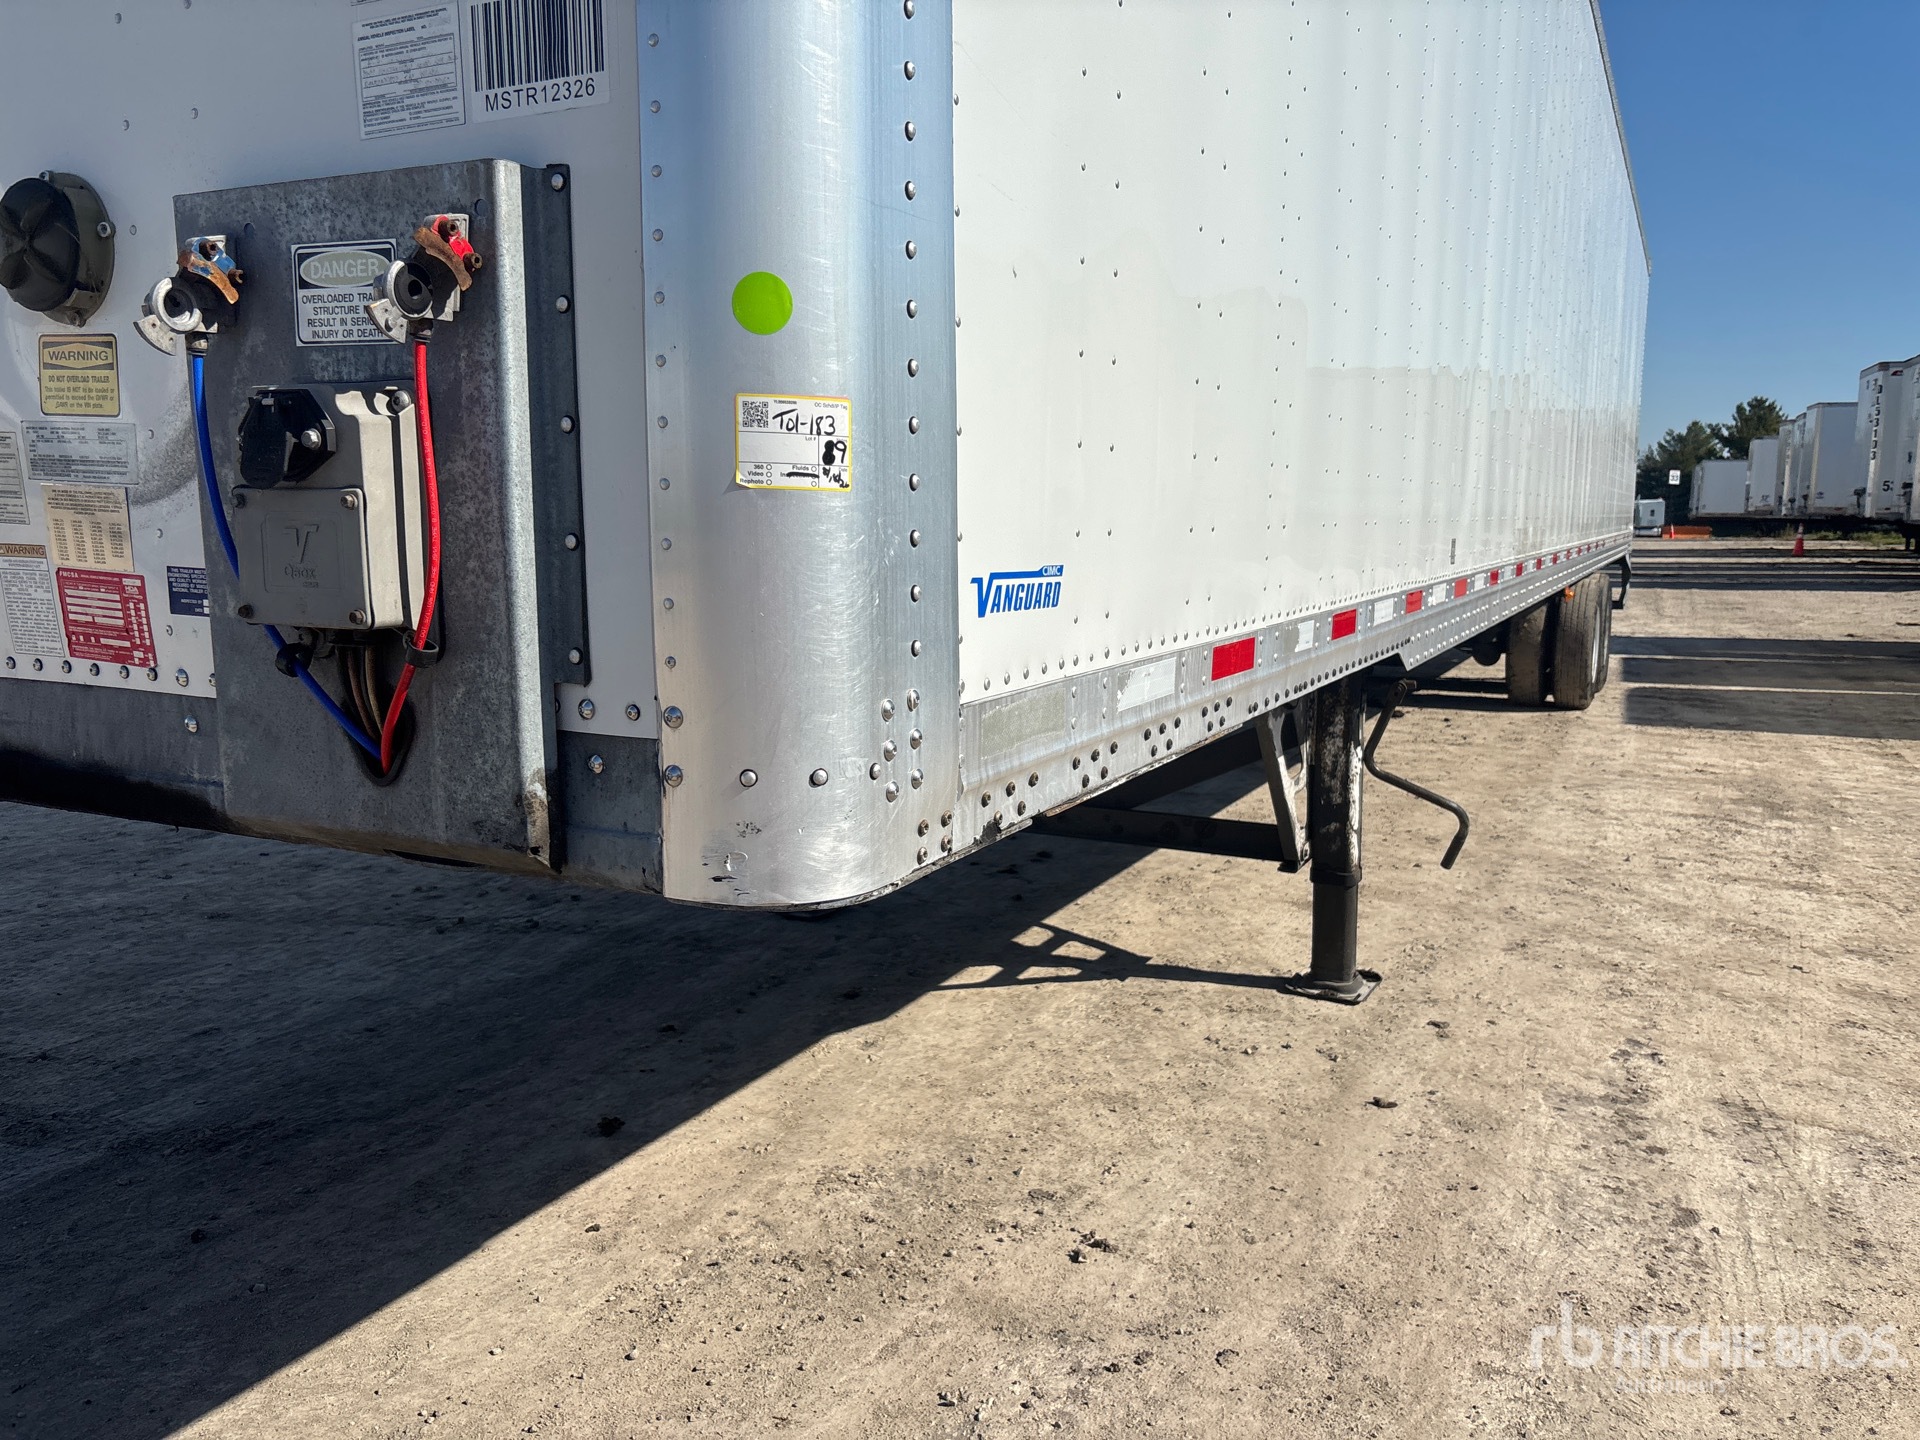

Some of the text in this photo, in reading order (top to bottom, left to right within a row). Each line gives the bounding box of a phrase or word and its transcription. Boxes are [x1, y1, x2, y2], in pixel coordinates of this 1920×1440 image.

[485, 77, 596, 112] MSTR12326
[310, 258, 379, 279] DANGER
[301, 293, 354, 305] OVERLOADED
[313, 305, 360, 316] STRUCTURE
[307, 317, 336, 327] RESULT
[340, 317, 348, 326] IN
[312, 329, 339, 339] INJURY
[342, 329, 354, 338] OR
[48, 350, 109, 361] WARNING
[48, 375, 56, 383] DO
[56, 375, 65, 383] NOT
[66, 375, 90, 383] OVERLOAD
[5, 545, 45, 556] WARNING
[59, 570, 79, 578] FMCSA
[1042, 565, 1061, 576] CIMC
[970, 571, 1062, 618] VANGUARD
